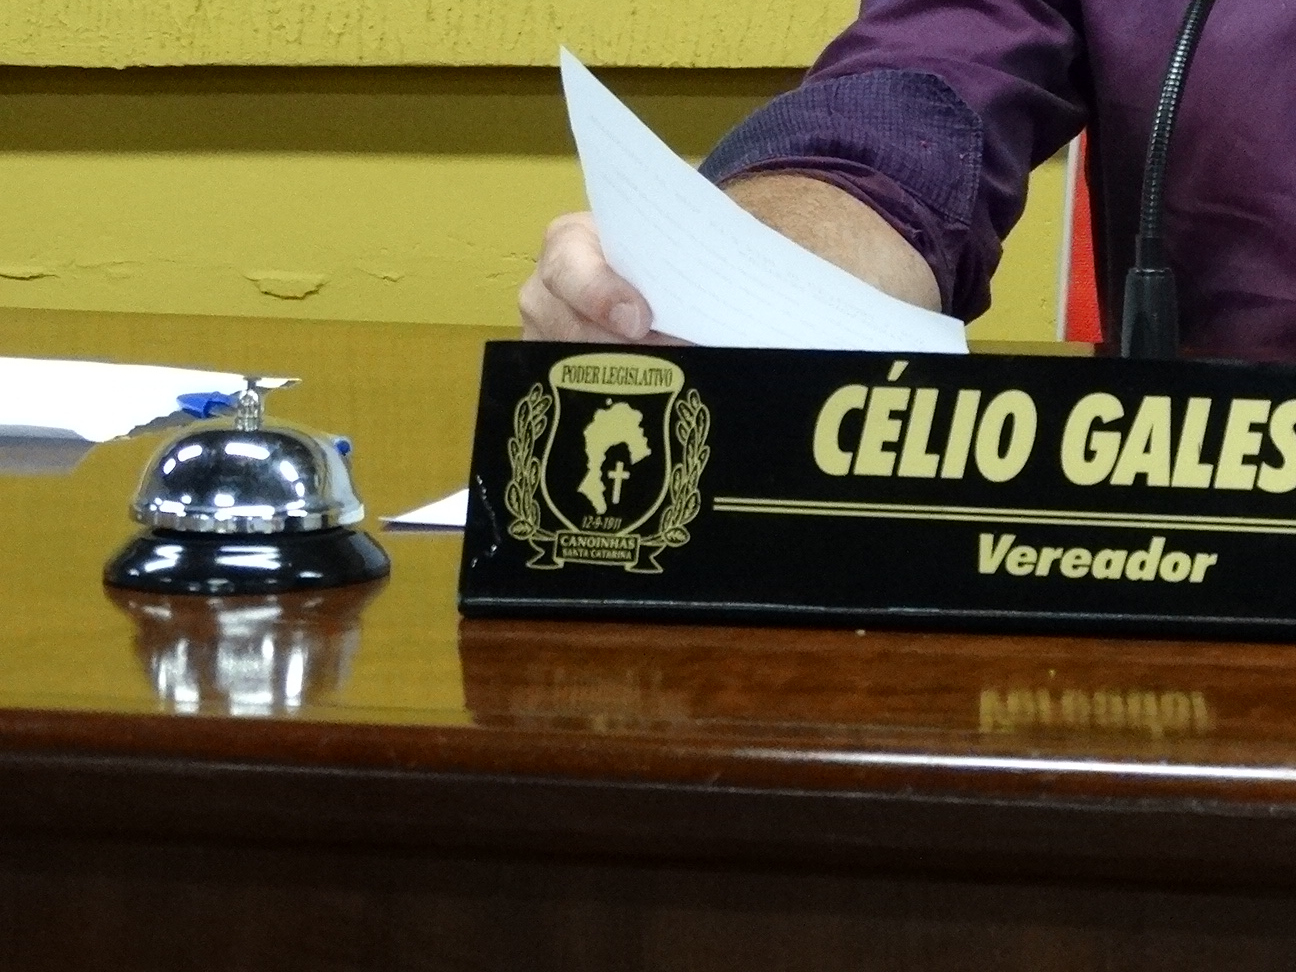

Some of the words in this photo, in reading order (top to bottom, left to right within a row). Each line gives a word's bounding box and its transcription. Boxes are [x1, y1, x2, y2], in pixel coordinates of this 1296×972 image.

[561, 364, 600, 384] PODER
[601, 366, 673, 387] LEGISLATIVO
[813, 360, 1038, 483] CÉLIO
[560, 535, 636, 550] CANOINHAS
[562, 548, 589, 558] SANTA
[590, 549, 632, 560] CATARINA
[978, 533, 1218, 583] Vereador
